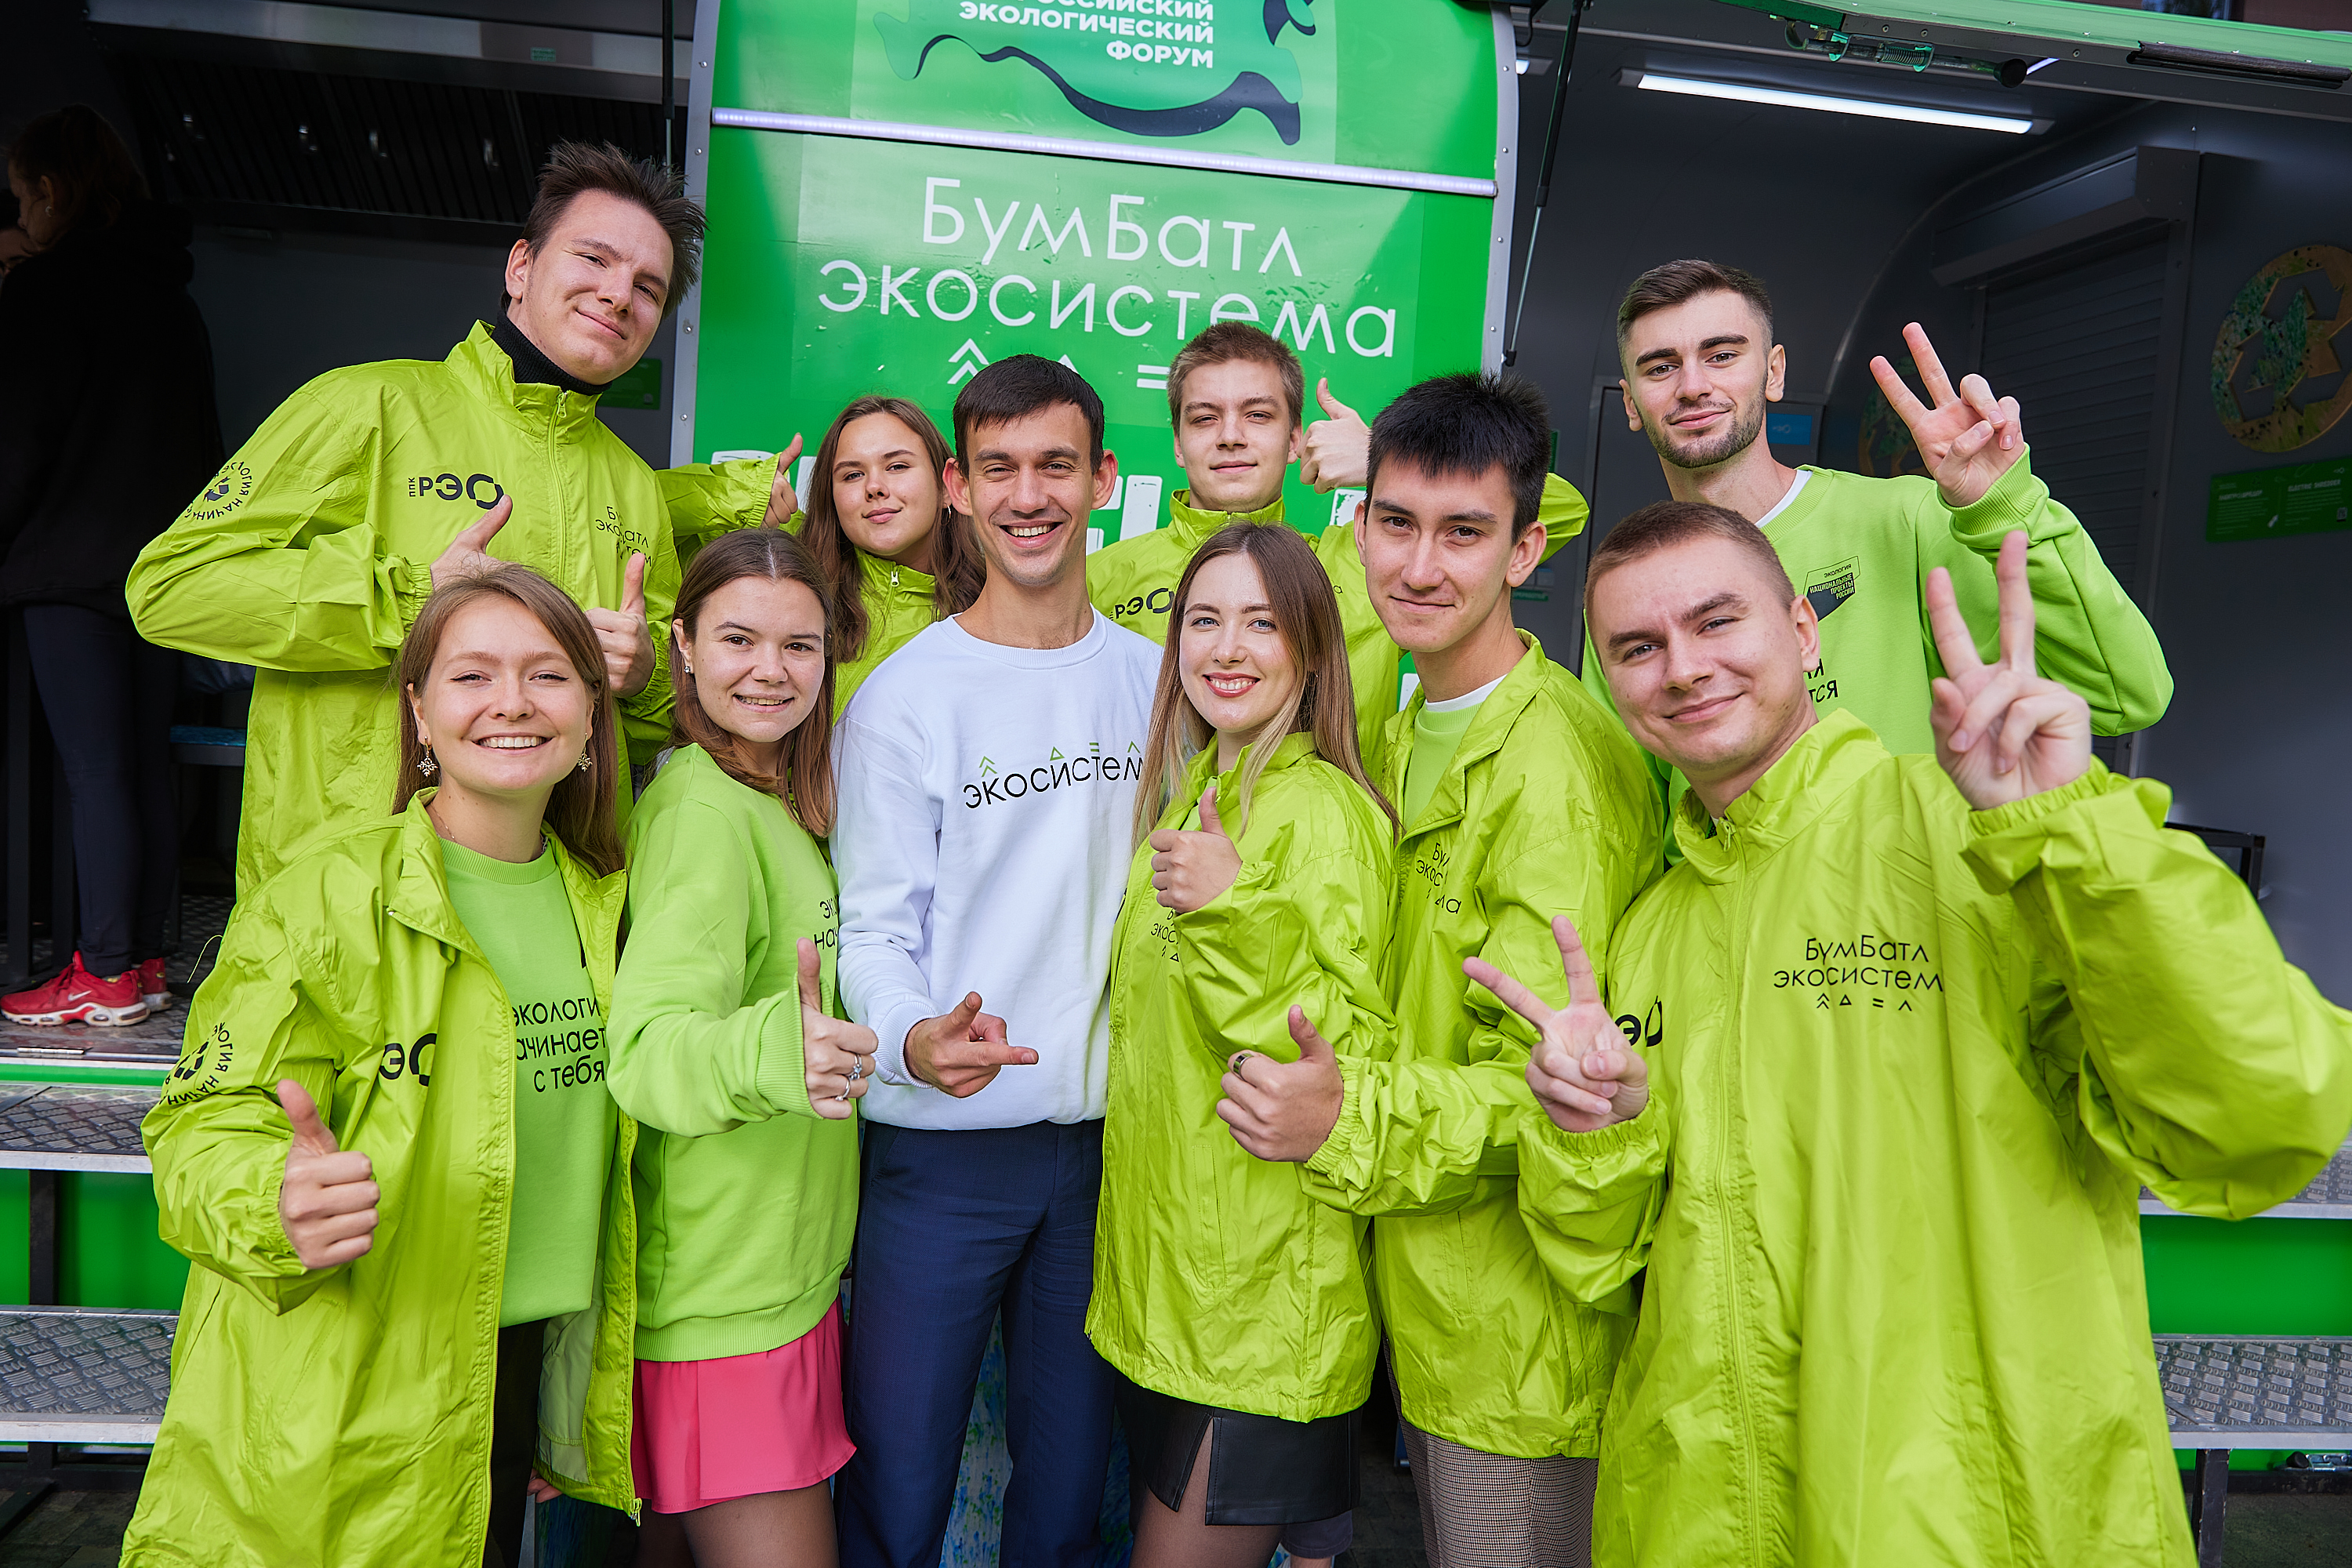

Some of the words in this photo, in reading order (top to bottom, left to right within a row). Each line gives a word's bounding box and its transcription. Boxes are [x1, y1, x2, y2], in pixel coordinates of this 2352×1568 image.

[959, 1, 1213, 44] ЭКОЛОГИЧЕСКИЙ
[1106, 40, 1213, 68] ФОРУМ
[923, 176, 1302, 277] БумБатл
[408, 477, 416, 497] ППК
[419, 473, 504, 510] РЭО
[1809, 573, 1853, 593] НАЦИОНАЛЬНЫЕ
[1830, 580, 1853, 595] ПРОЕКТЫ
[1835, 586, 1854, 600] РОССИИ
[1115, 587, 1174, 619] РЭО
[963, 757, 1144, 808] экосистем
[1806, 935, 1929, 965] БумБатл
[1773, 967, 1944, 992] экосистем
[512, 996, 601, 1026] кологи
[1613, 995, 1663, 1047] ЭО
[379, 1033, 437, 1087] ЭО
[516, 1027, 605, 1061] ачинает
[534, 1069, 546, 1093] с
[550, 1054, 605, 1090] тебя
